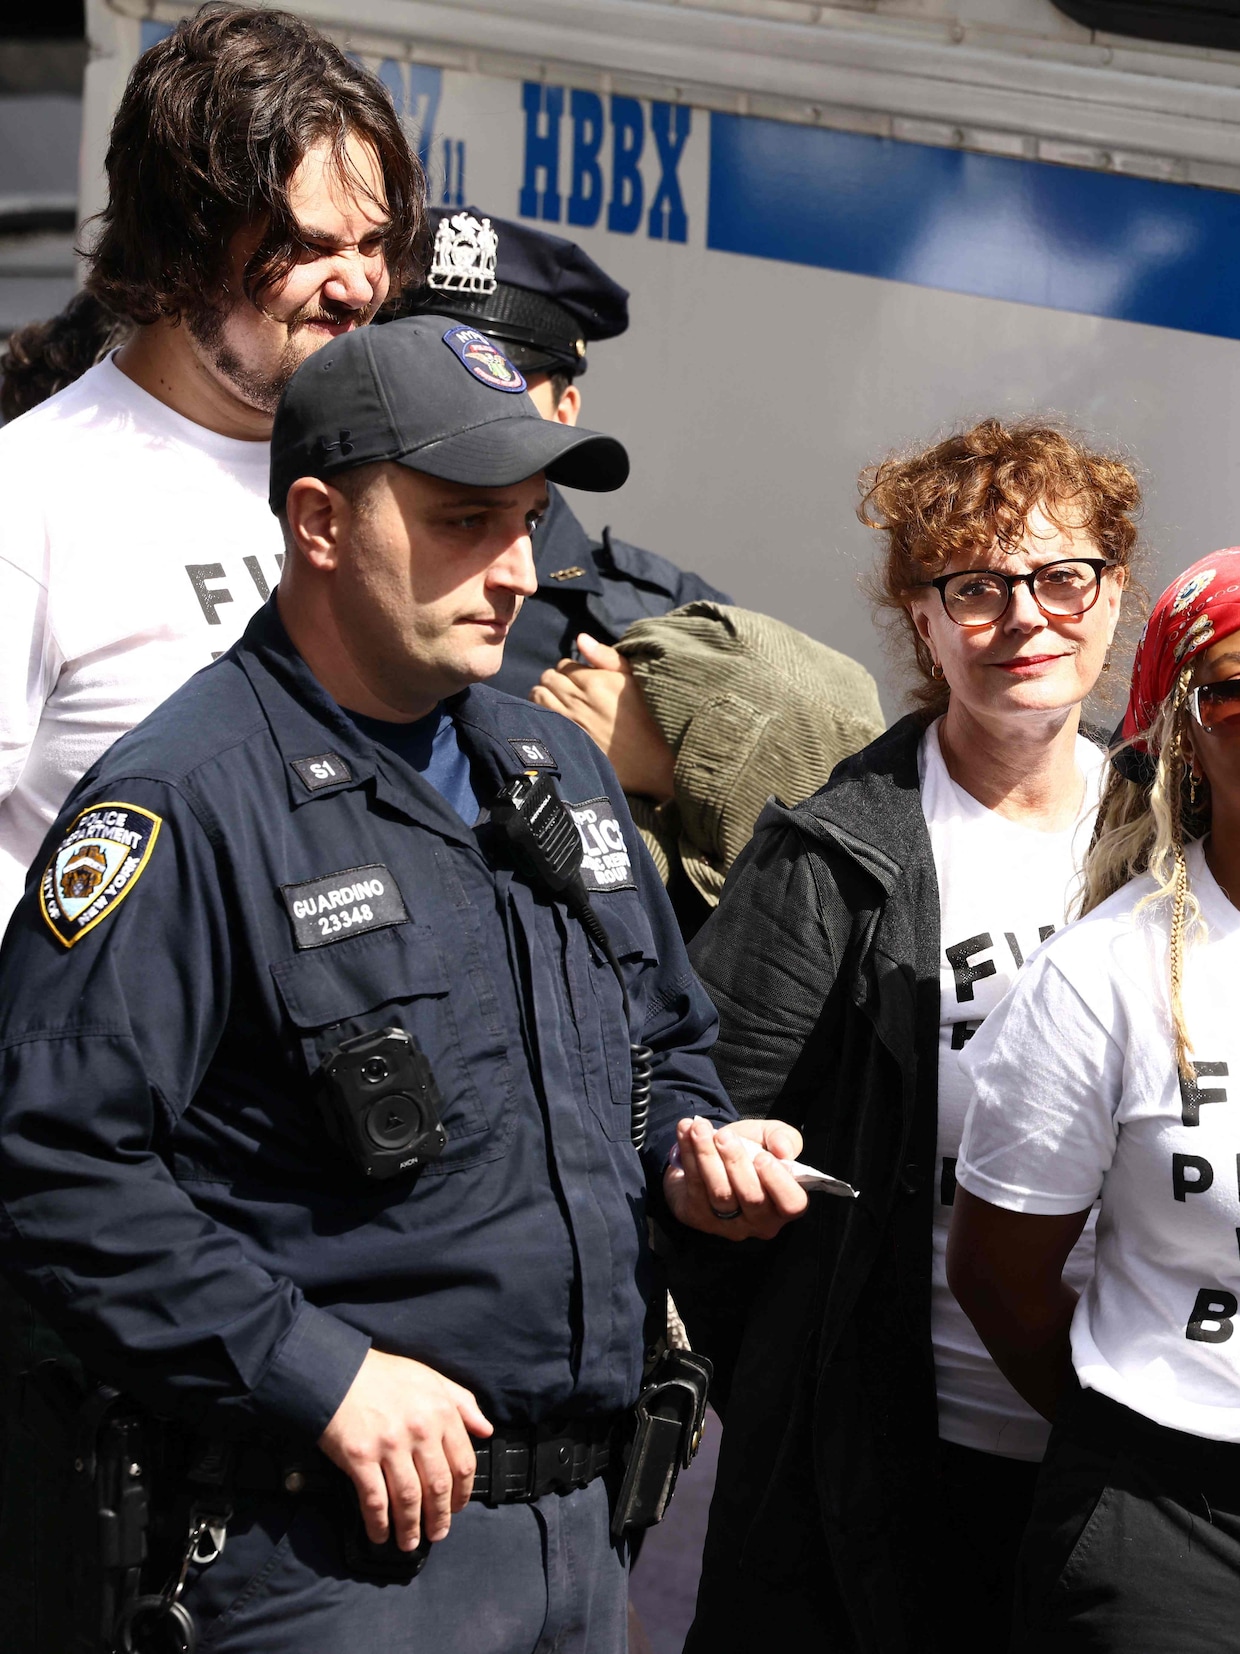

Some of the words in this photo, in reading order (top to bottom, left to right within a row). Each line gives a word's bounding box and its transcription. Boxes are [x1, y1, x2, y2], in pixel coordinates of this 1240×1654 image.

[518, 80, 692, 245] HBBX
[522, 744, 545, 760] S1
[309, 760, 337, 780] S1
[78, 810, 129, 828] POLICE
[104, 856, 141, 896] YORK
[293, 879, 385, 919] GUARDINO
[318, 904, 374, 936] 23348
